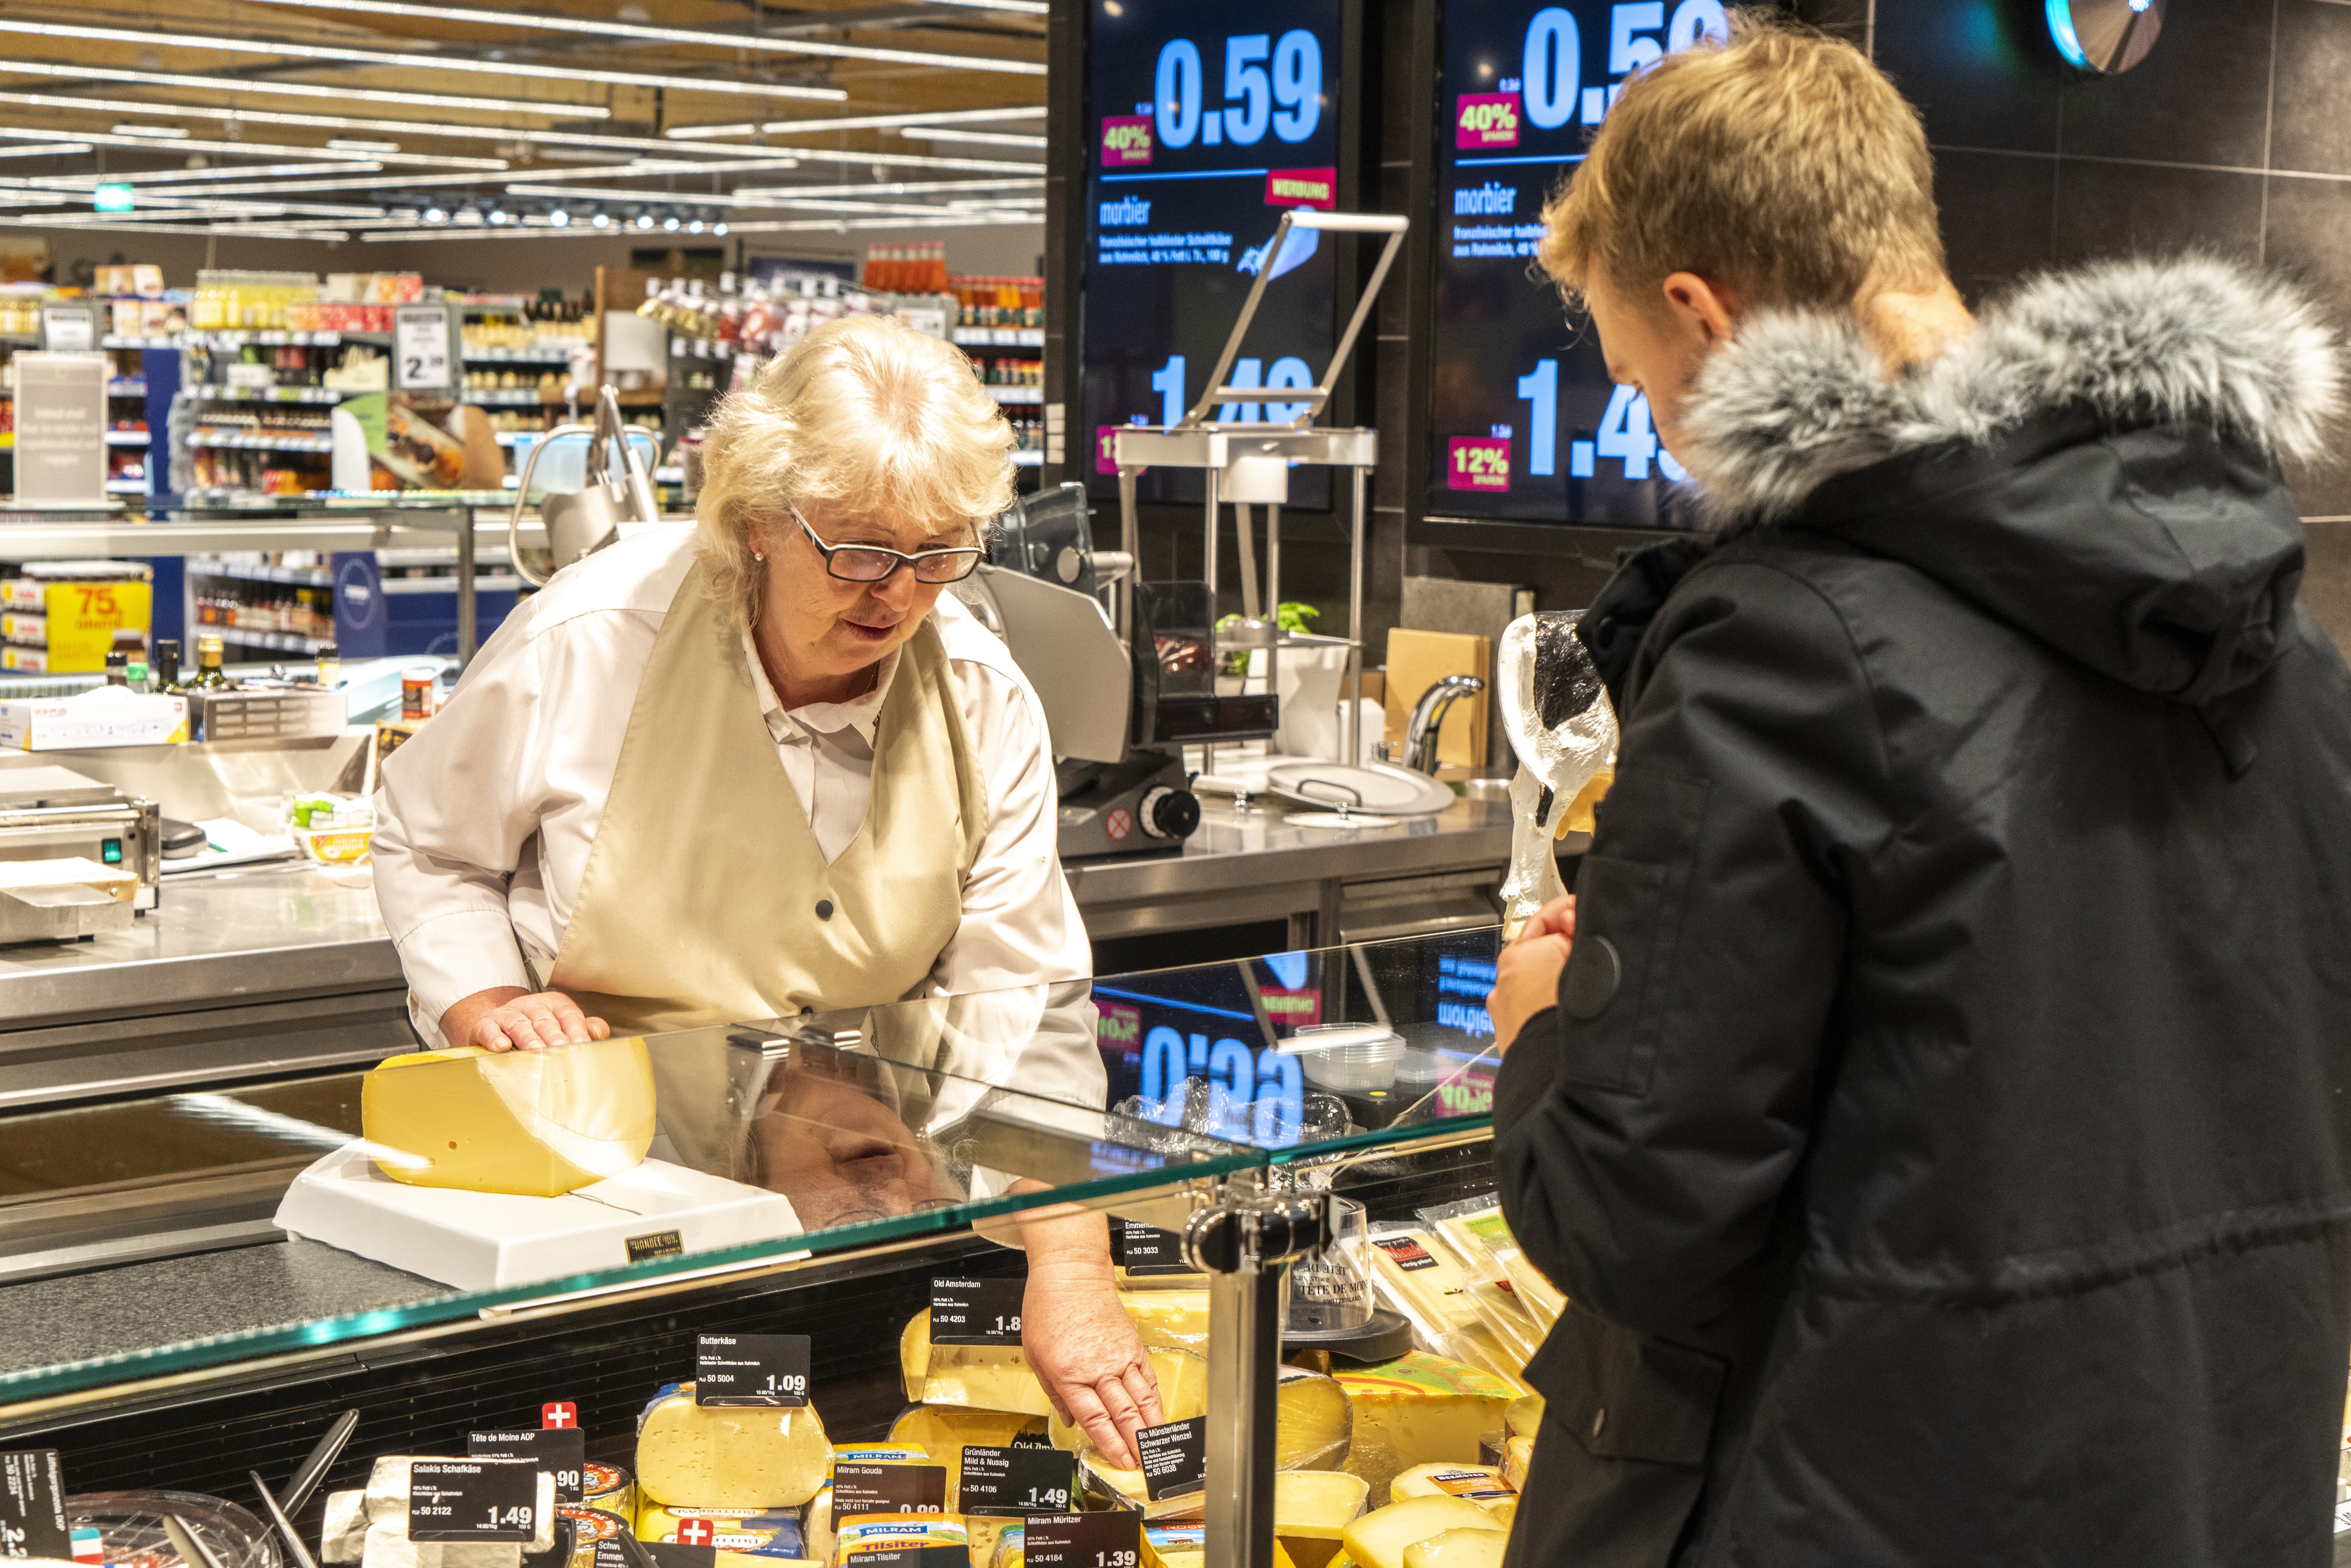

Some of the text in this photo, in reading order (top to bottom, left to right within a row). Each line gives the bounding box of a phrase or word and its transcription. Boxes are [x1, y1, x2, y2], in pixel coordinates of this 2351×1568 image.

[1155, 29, 1322, 150] 0.59
[1460, 102, 1517, 131] 40%
[1104, 125, 1151, 150] 40%
[1271, 178, 1330, 200] WERBUNG
[1454, 181, 1517, 215] morbier
[1099, 195, 1152, 226] morbier
[1517, 359, 1688, 482] 1.4
[1453, 447, 1510, 474] 12%
[1300, 1284, 1329, 1295] TÊTE
[1333, 1284, 1346, 1294] DE
[1323, 1295, 1361, 1304] SWITZERLAND
[700, 1336, 736, 1345] Butterkäse
[766, 1375, 805, 1391] 1.09
[1149, 1423, 1190, 1437] Münsterländer
[1140, 1431, 1192, 1449] Schwarzer Wenzel
[965, 1448, 1001, 1457] Grünländer
[413, 1465, 481, 1473] Salakis Schafkäse
[987, 1459, 1009, 1467] Nussig
[1161, 1464, 1176, 1473] 6038
[1029, 1487, 1067, 1504] 1.49
[432, 1506, 451, 1515] 2122
[488, 1506, 532, 1524] 1.49
[862, 1541, 930, 1551] Tilsiter
[1096, 1551, 1136, 1567] 1.39
